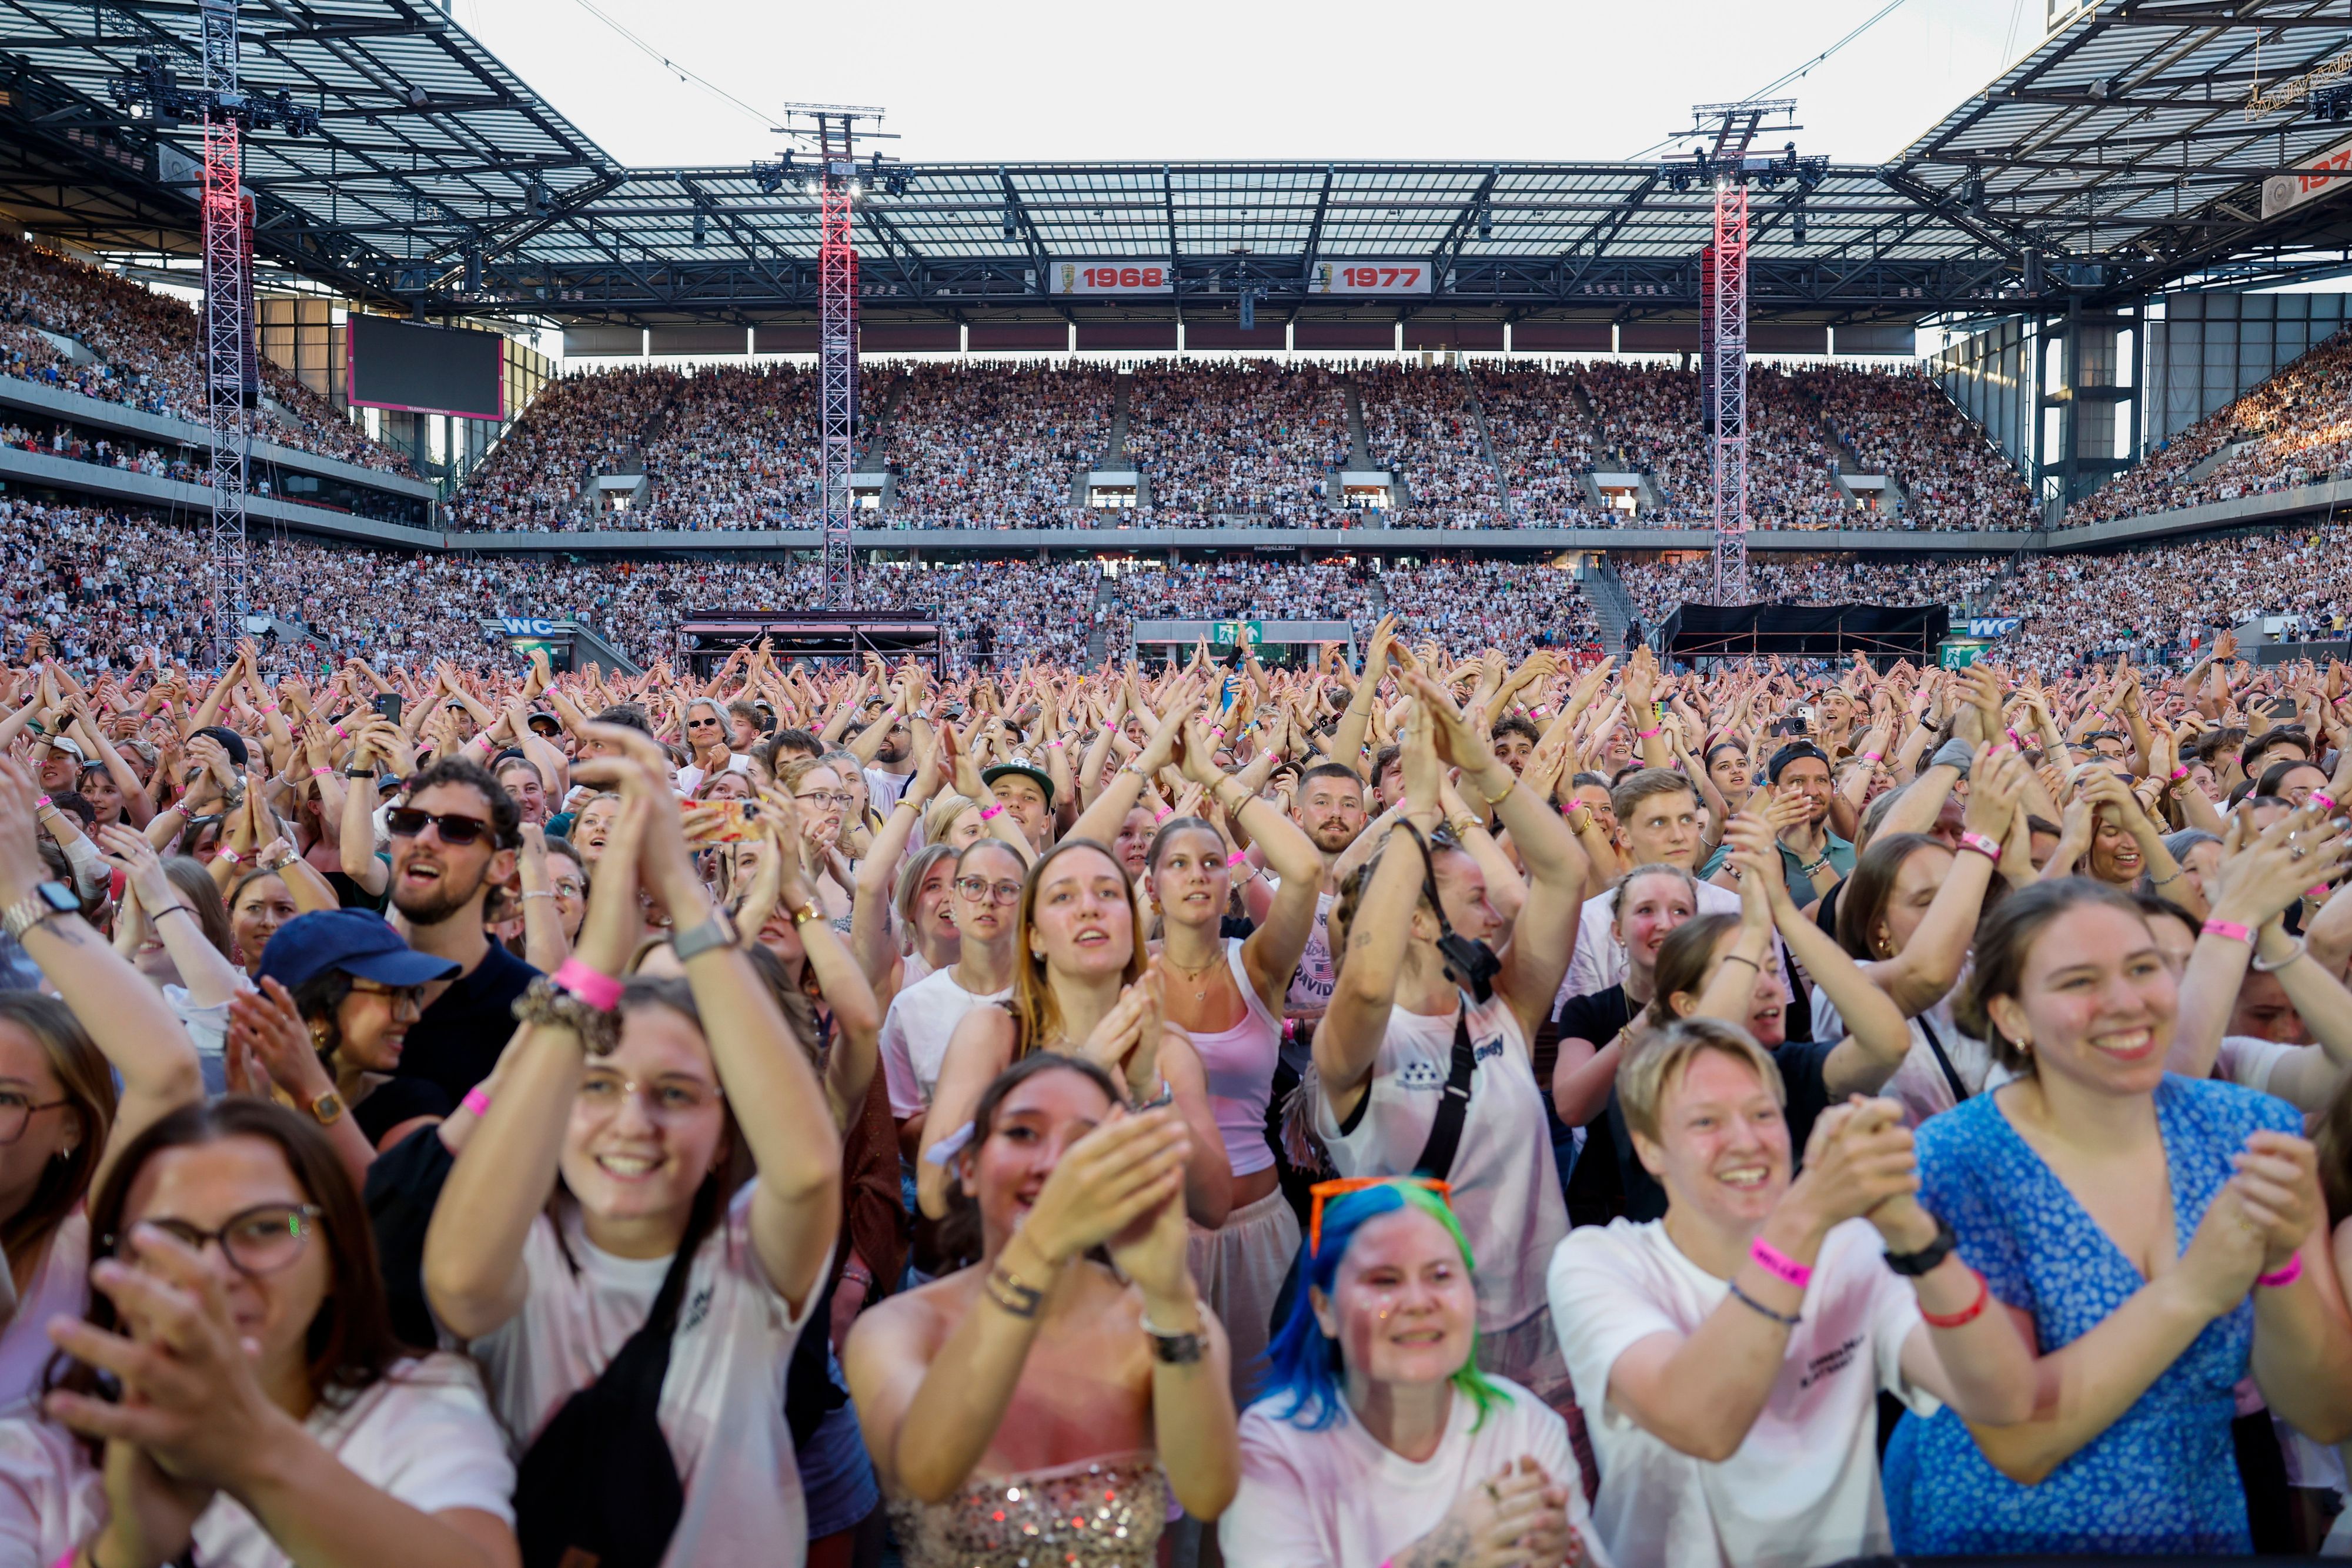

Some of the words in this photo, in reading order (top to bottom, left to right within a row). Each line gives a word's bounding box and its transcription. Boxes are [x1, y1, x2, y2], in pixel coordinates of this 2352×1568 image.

[2298, 149, 2352, 193] 197
[1083, 268, 1162, 287] 1968
[1343, 268, 1421, 287] 1977
[502, 618, 553, 634] WC
[1970, 619, 2019, 635] WC
[1295, 963, 1335, 996] DAVID
